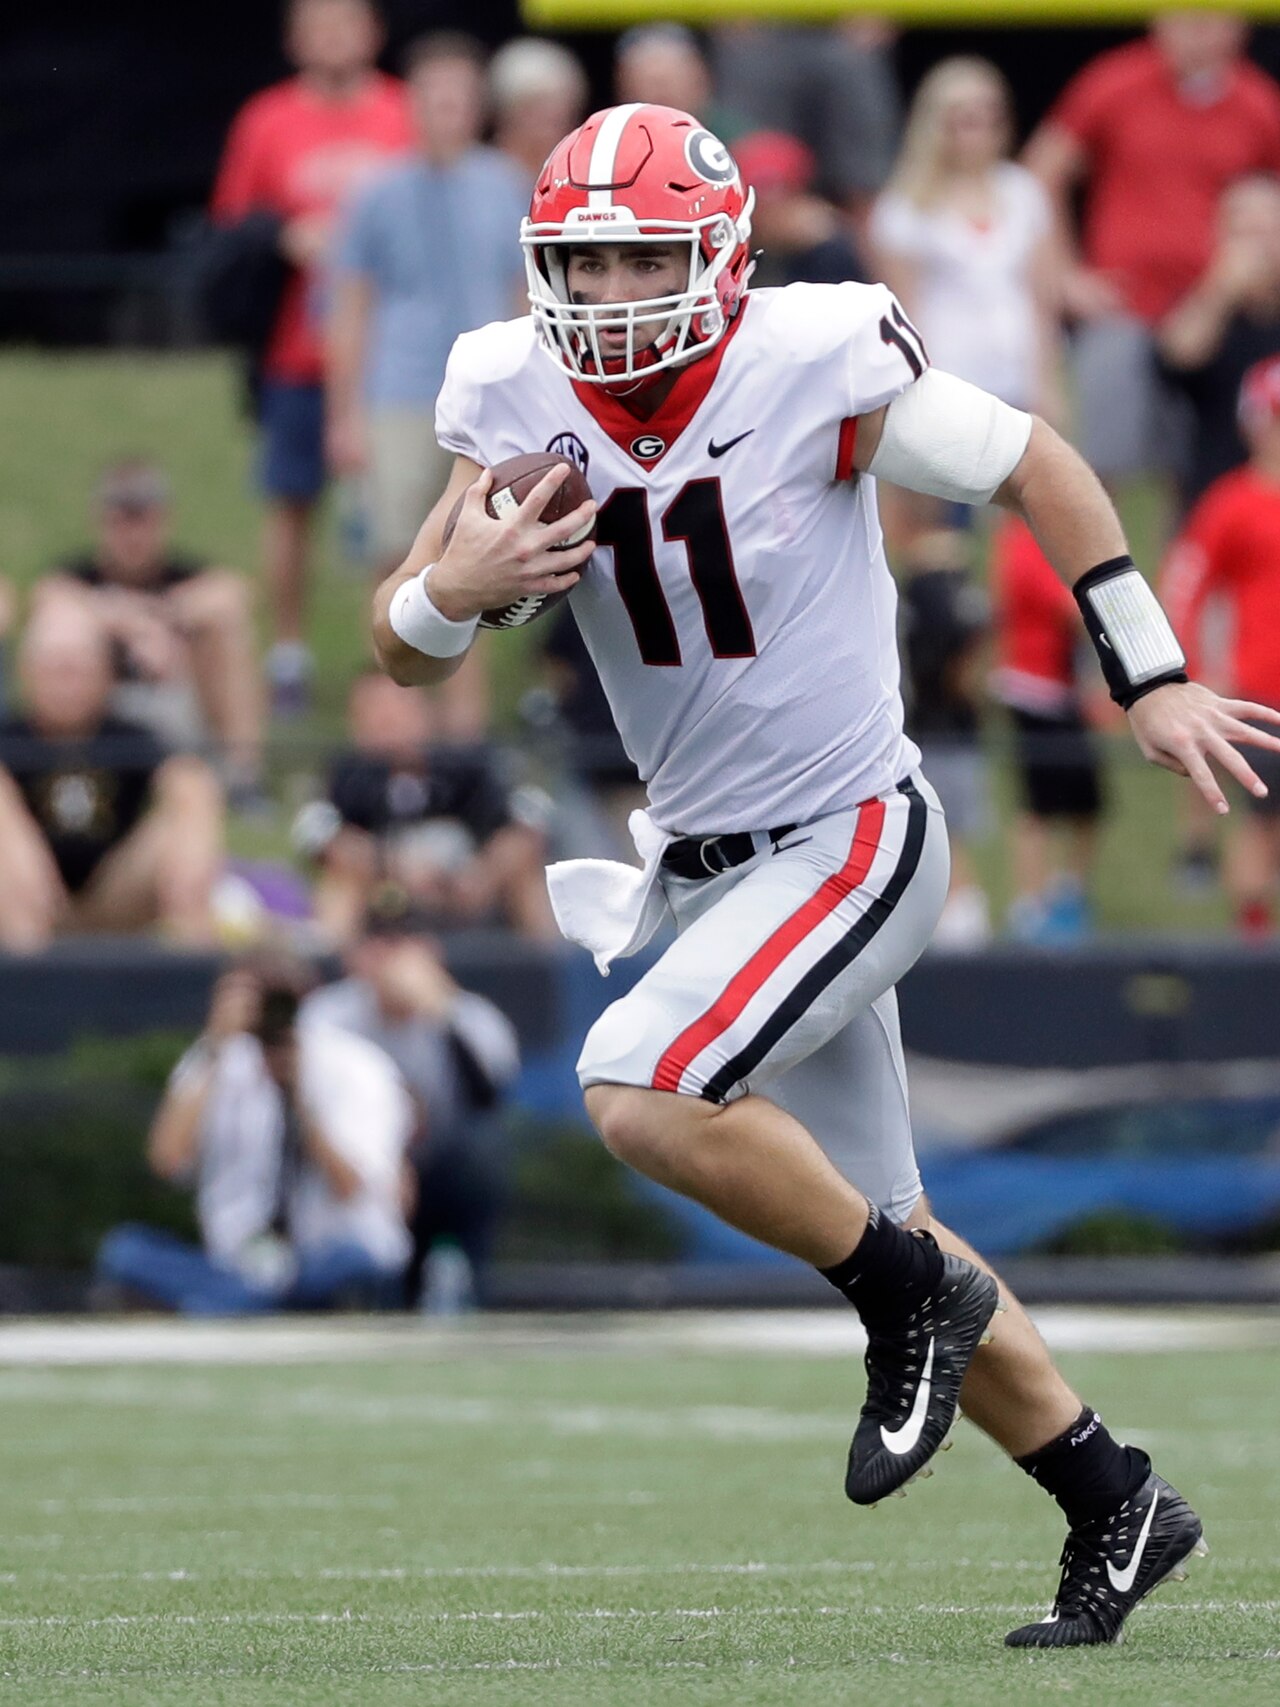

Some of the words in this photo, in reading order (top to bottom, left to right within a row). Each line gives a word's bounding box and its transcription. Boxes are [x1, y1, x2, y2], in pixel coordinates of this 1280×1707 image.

[688, 131, 738, 182] G
[577, 212, 617, 222] DAWGS
[632, 436, 664, 458] G
[596, 476, 757, 666] 11
[1071, 1421, 1097, 1446] NIKE
